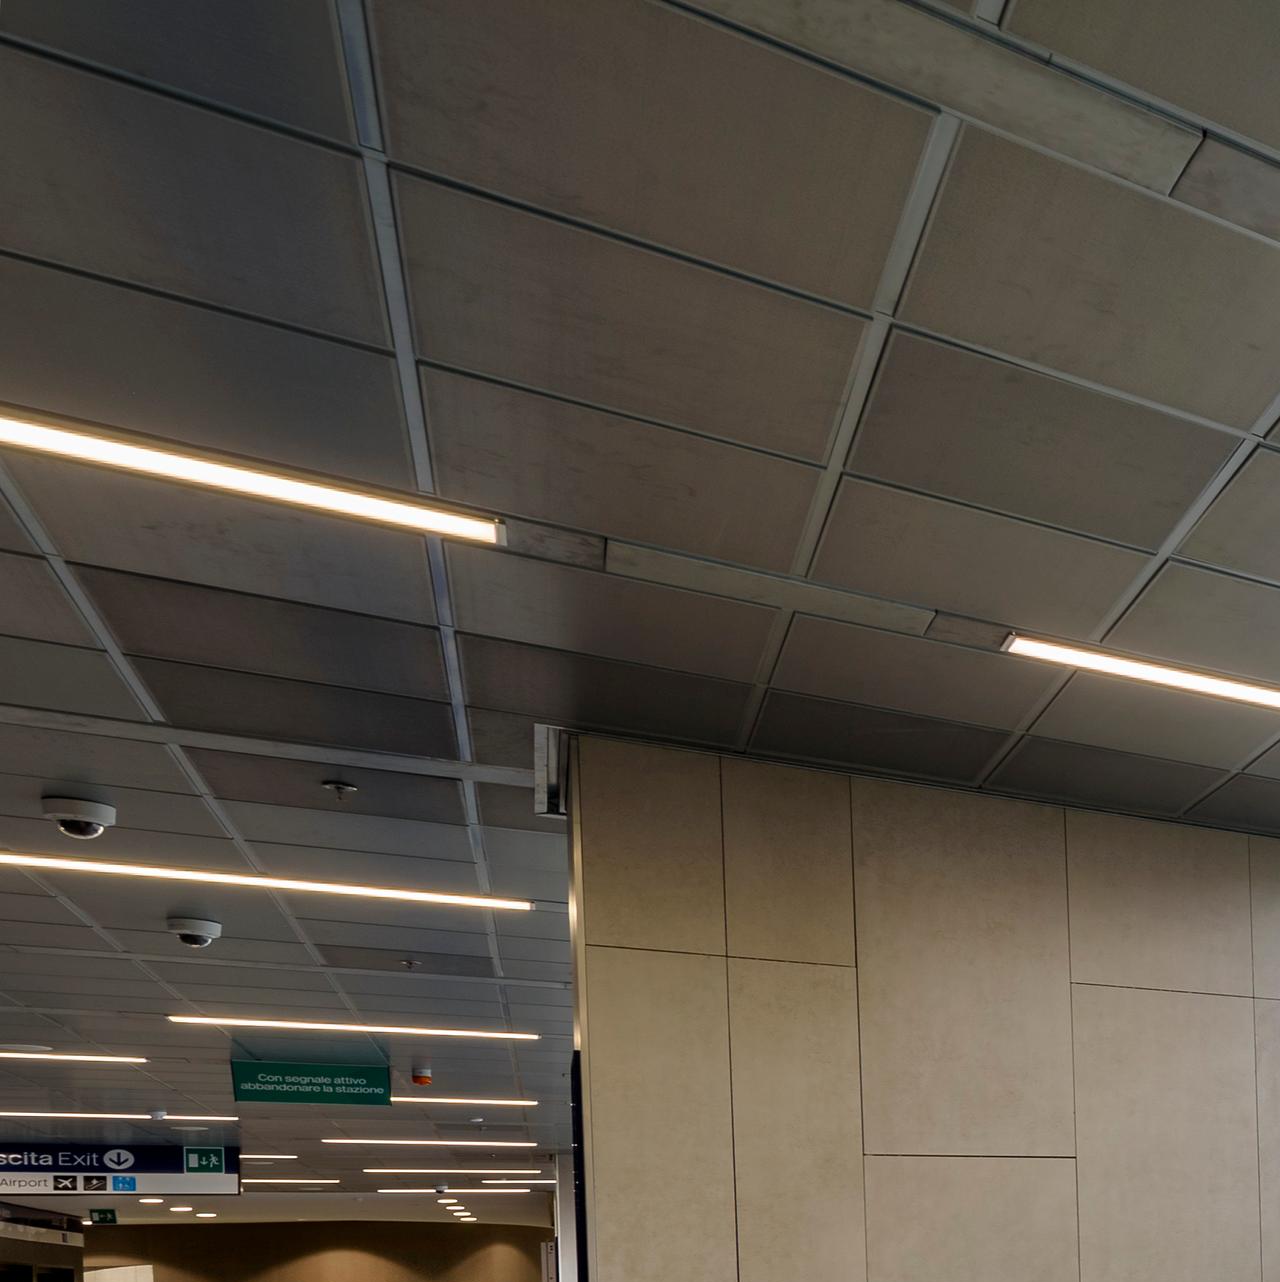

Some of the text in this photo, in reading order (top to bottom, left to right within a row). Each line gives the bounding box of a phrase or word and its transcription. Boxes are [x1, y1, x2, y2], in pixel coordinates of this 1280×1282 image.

[257, 1073, 367, 1084] Con segnale attivo
[240, 1082, 384, 1094] abbandonare la stazione
[58, 1152, 99, 1166] Exit
[0, 1178, 48, 1188] Airport
